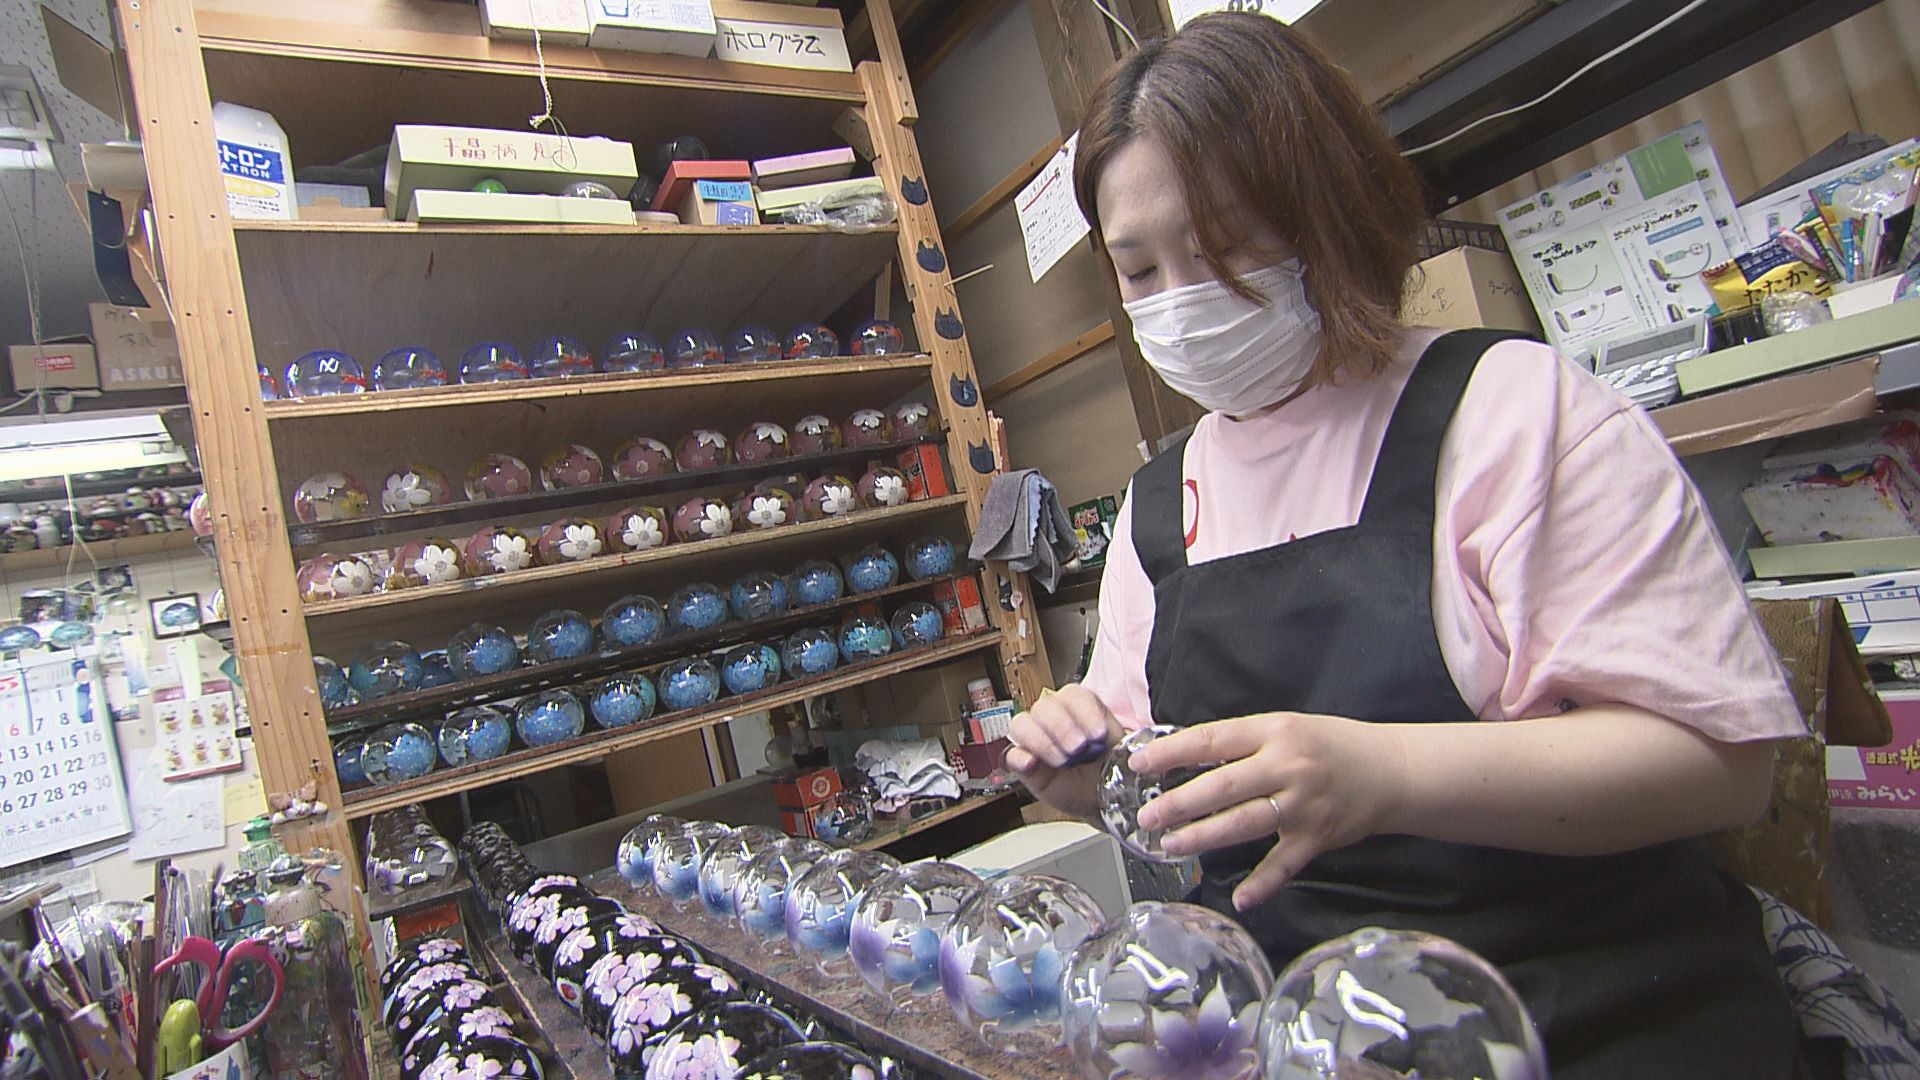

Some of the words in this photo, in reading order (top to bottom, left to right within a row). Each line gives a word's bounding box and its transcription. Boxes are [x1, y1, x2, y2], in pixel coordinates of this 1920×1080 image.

[109, 365, 182, 383] ASKUL
[9, 723, 20, 737] 6
[35, 717, 44, 732] 7
[59, 712, 70, 726] 8
[9, 746, 30, 762] 13
[36, 740, 54, 756] 14
[61, 734, 79, 750] 15
[84, 729, 103, 745] 16
[13, 769, 34, 786] 20
[40, 763, 59, 779] 21
[64, 757, 84, 773] 22
[88, 752, 108, 766] 23
[18, 792, 38, 810] 27
[44, 787, 64, 803] 28
[69, 780, 88, 797] 29
[93, 775, 112, 791] 30
[1856, 784, 1917, 802] みらい
